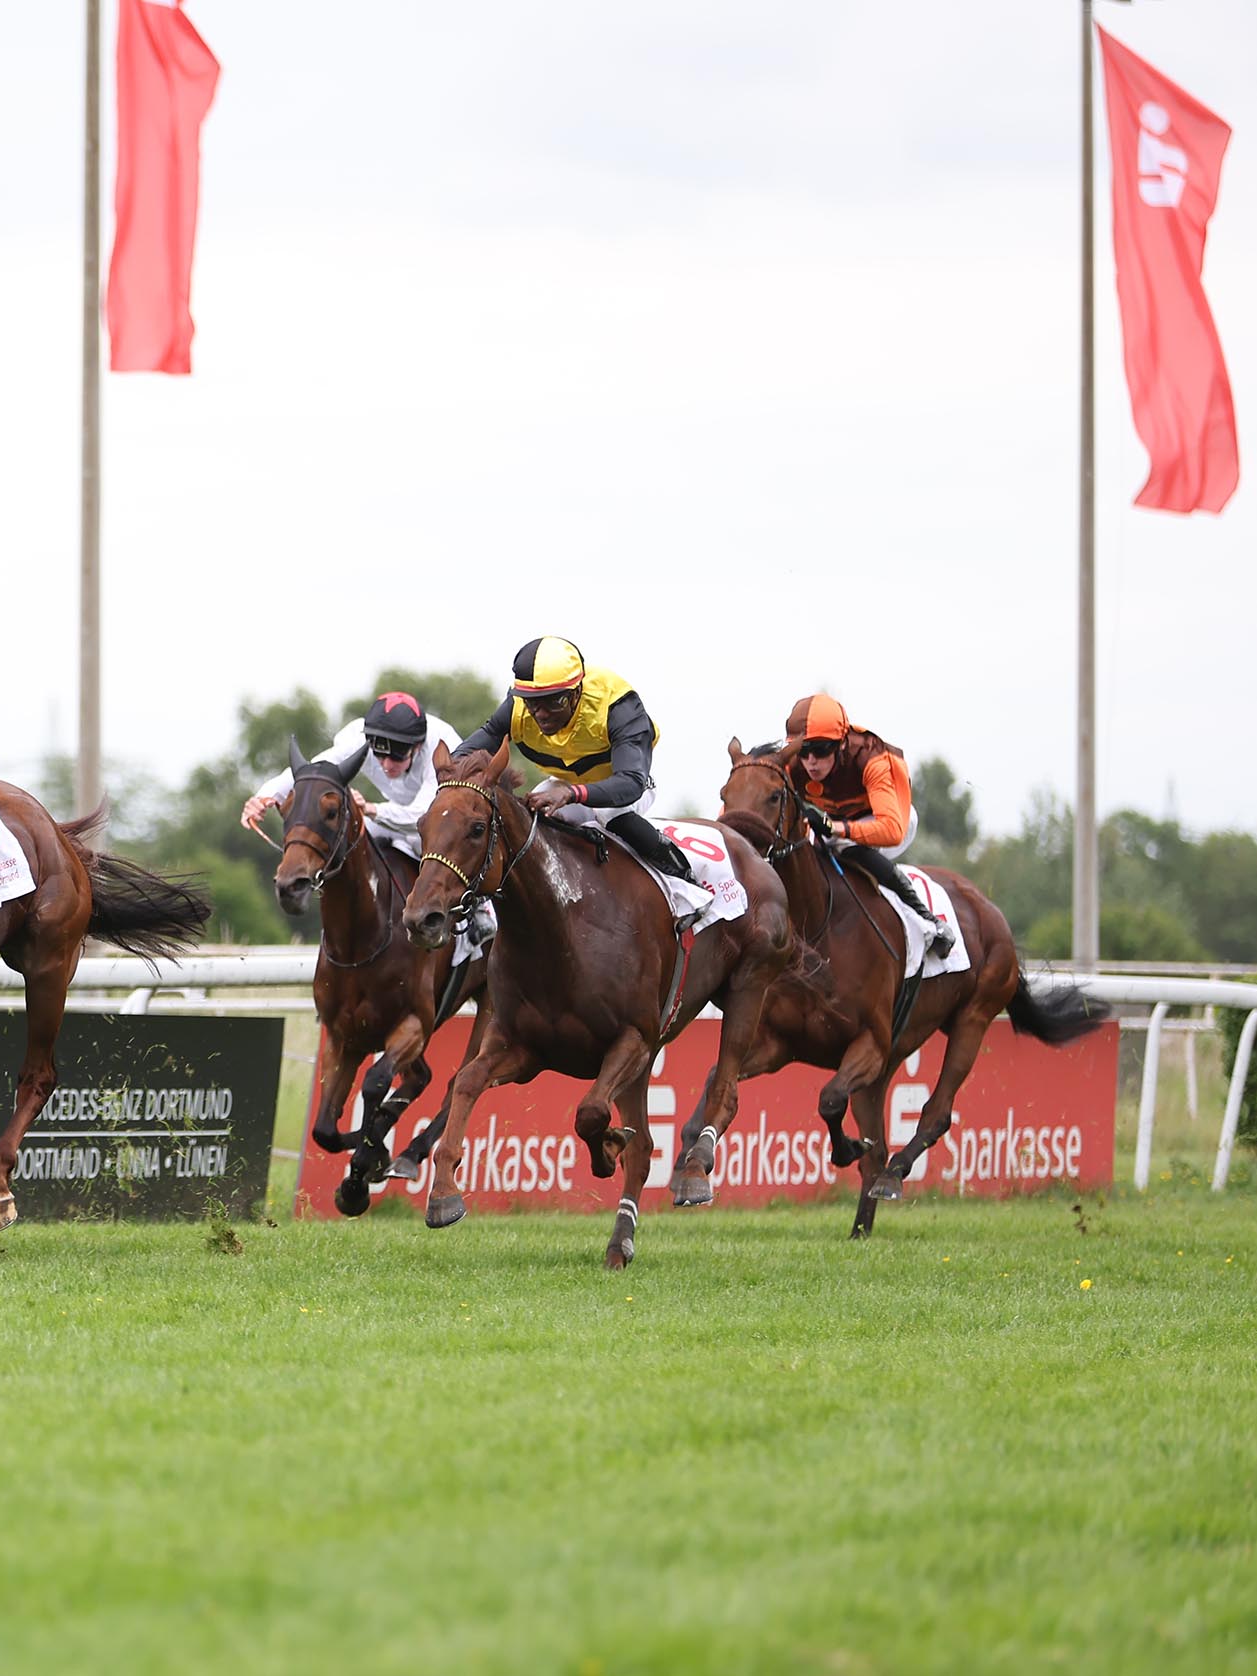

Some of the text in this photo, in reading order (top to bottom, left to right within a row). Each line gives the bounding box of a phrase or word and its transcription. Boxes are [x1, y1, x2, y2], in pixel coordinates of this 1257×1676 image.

[663, 825, 725, 862] 6
[145, 1087, 233, 1120] DORTMUND
[709, 1110, 838, 1188] parkasse
[941, 1106, 1082, 1197] Sparkasse
